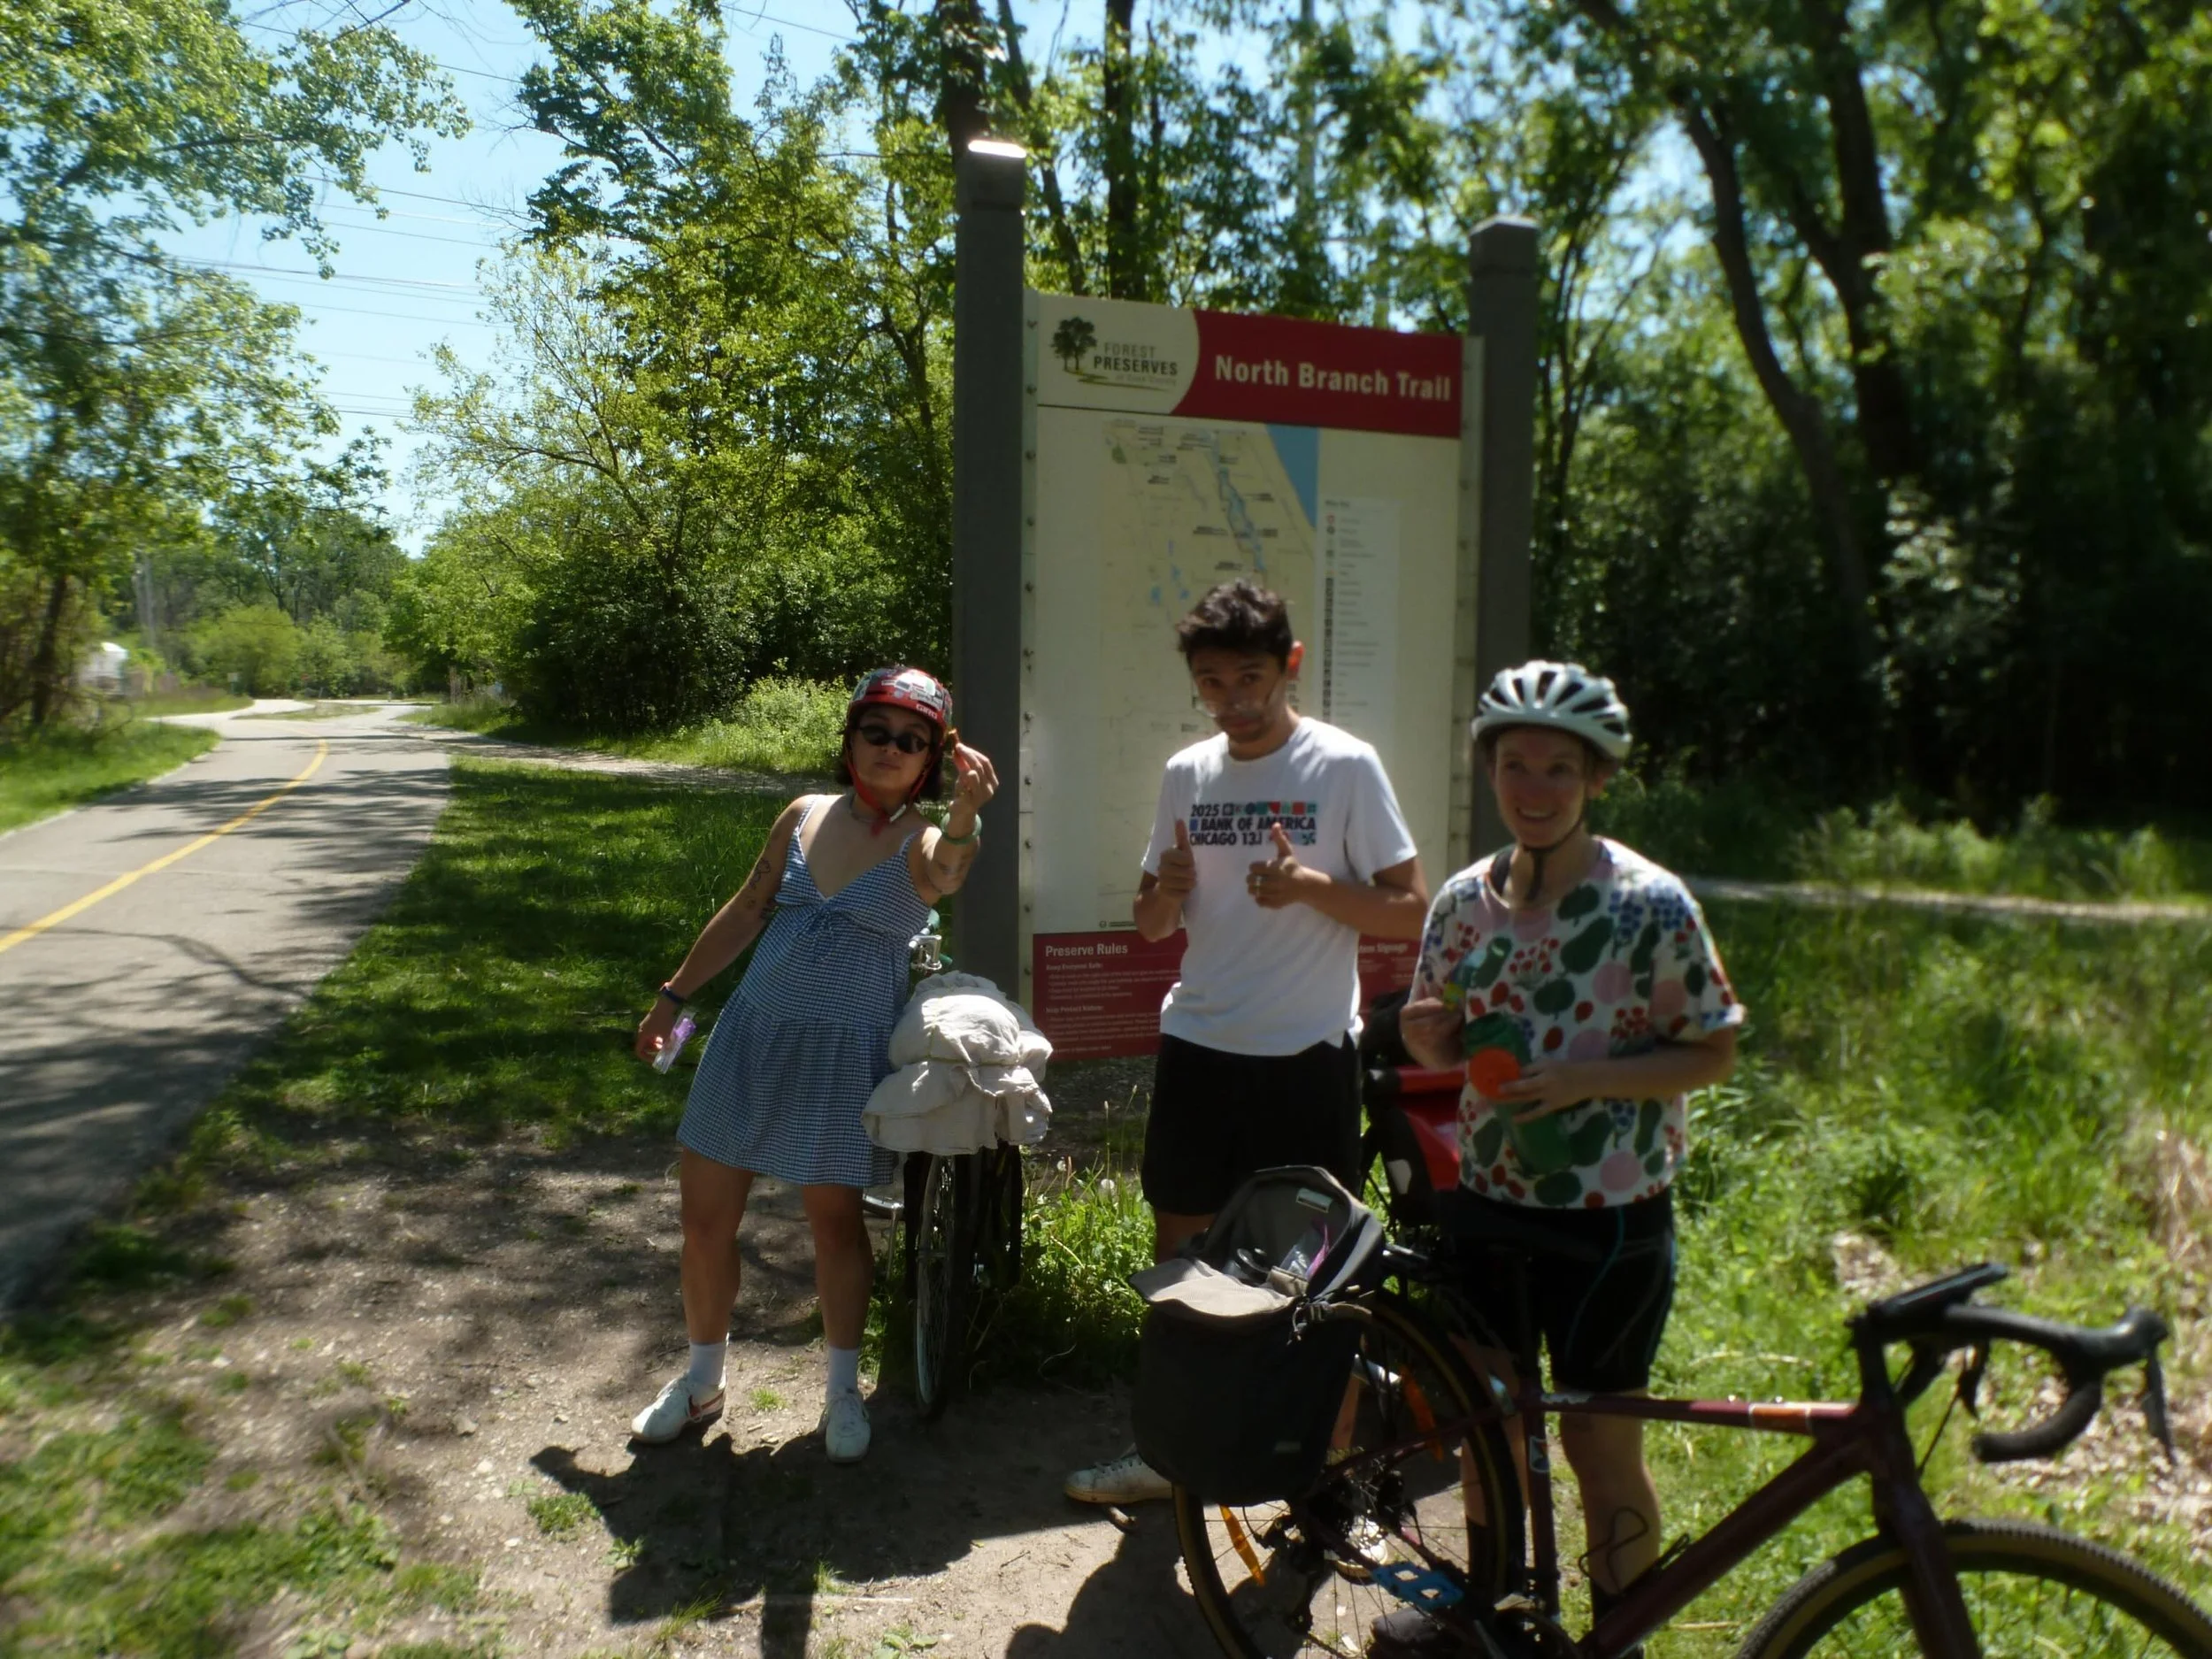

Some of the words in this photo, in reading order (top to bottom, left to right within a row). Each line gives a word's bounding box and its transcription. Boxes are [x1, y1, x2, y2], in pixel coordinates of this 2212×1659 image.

[1103, 342, 1156, 358] FOREST
[1094, 356, 1179, 375] PRESERVES
[1215, 355, 1289, 388] North
[1298, 361, 1389, 396] Branch
[1397, 371, 1451, 401] Trail
[1191, 803, 1219, 817] 2025
[1201, 817, 1233, 830] BANK
[1238, 817, 1252, 830] OF
[1189, 833, 1236, 846] CHICAGO
[1045, 945, 1094, 957] Preserve
[1096, 943, 1128, 955] Rules
